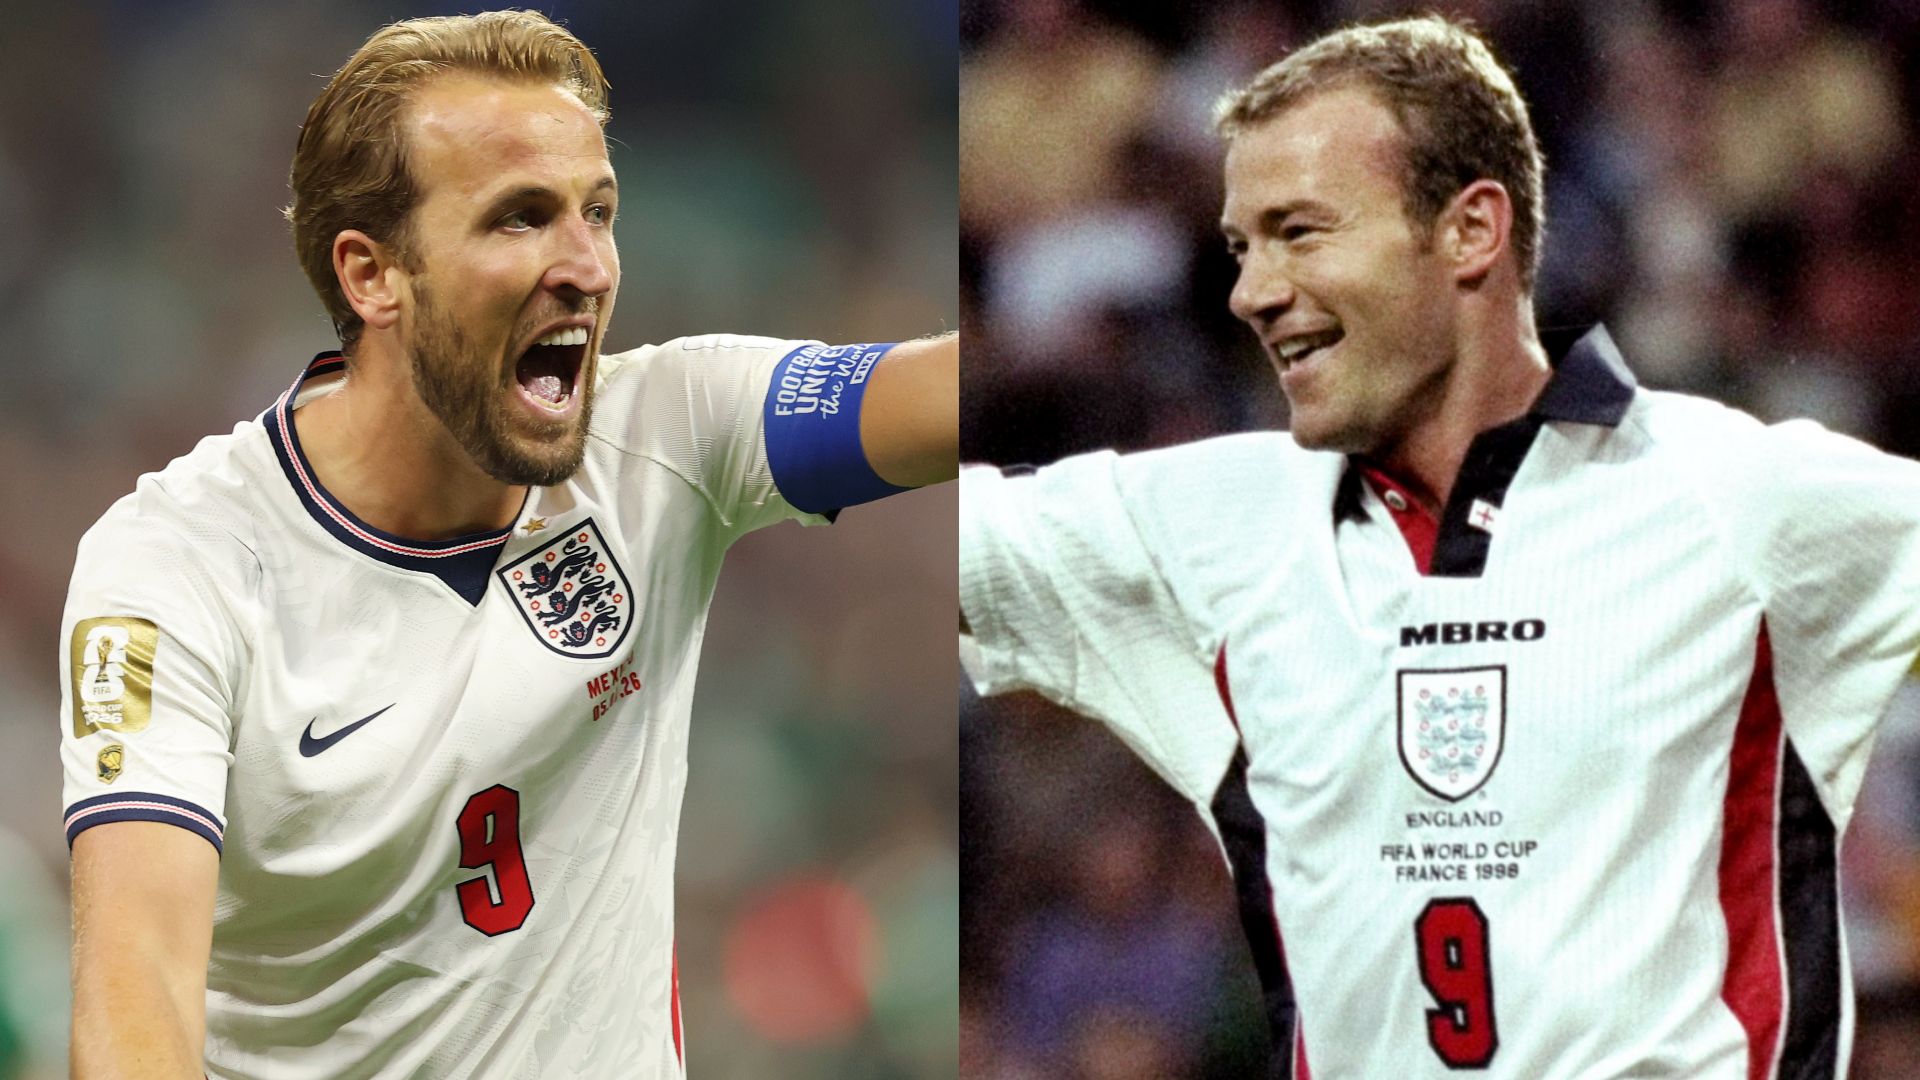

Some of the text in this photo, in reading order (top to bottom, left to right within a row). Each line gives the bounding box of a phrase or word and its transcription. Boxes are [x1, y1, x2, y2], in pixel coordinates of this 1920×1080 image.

[819, 380, 844, 420] the
[1400, 619, 1546, 647] MBRO
[92, 686, 112, 696] FIFA
[1405, 809, 1503, 829] ENGLAND
[456, 783, 536, 938] 9
[1380, 840, 1538, 862] FIFA WORLD CUP
[1395, 862, 1519, 883] FRANCE 1998
[1414, 896, 1499, 1071] 9
